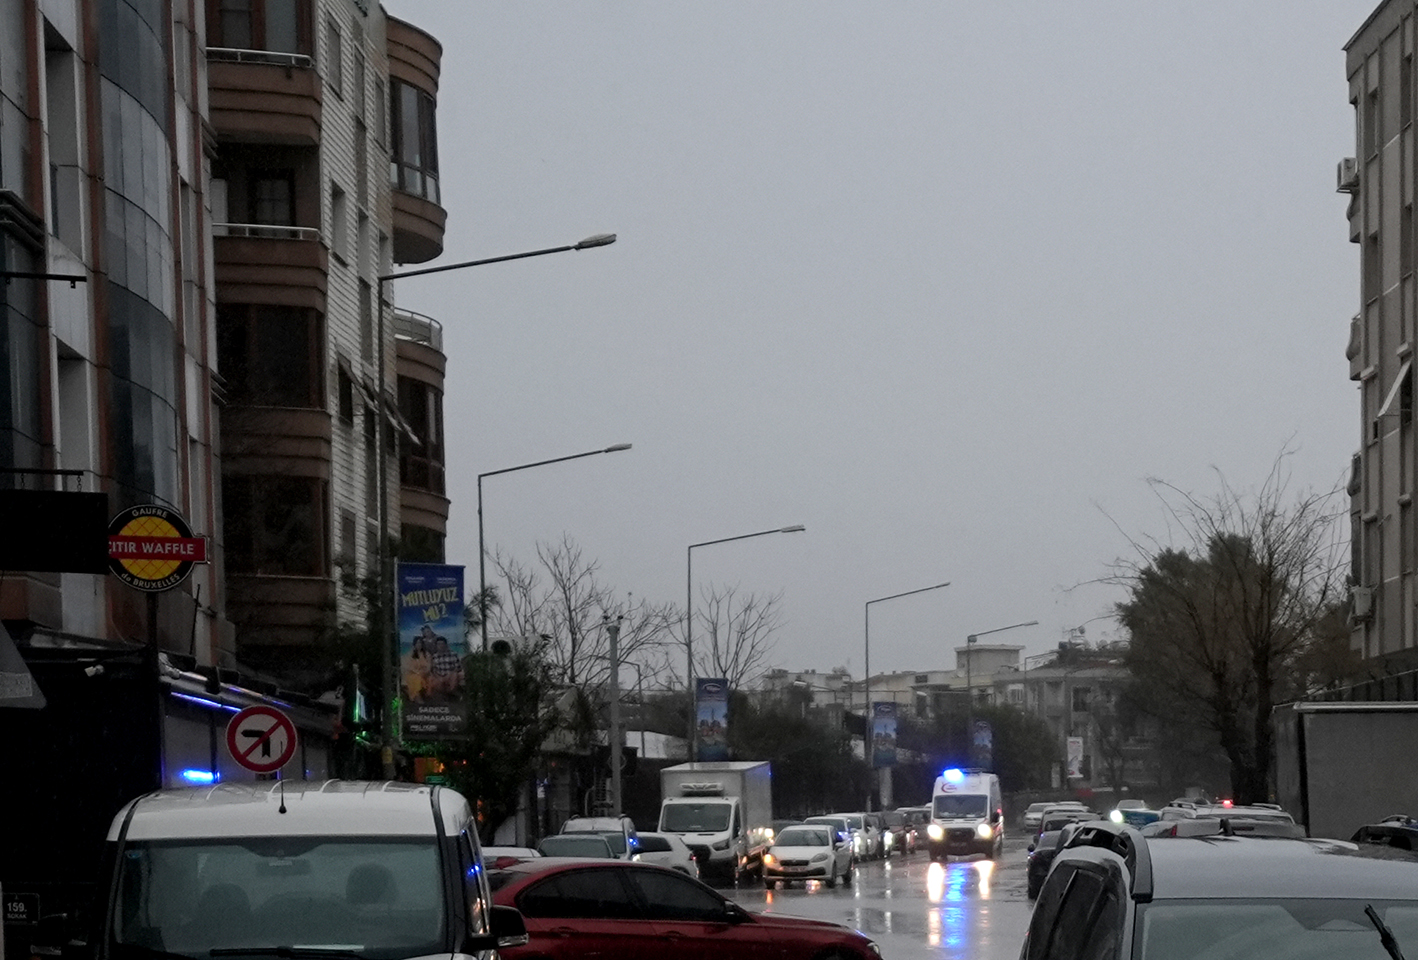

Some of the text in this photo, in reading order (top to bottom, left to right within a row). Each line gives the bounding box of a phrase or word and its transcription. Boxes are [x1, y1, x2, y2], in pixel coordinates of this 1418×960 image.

[131, 508, 169, 518] GAUFRE
[142, 542, 195, 555] WAFFLE
[132, 574, 181, 589] BRUXELLES
[401, 587, 459, 606] MUTLUYUZ
